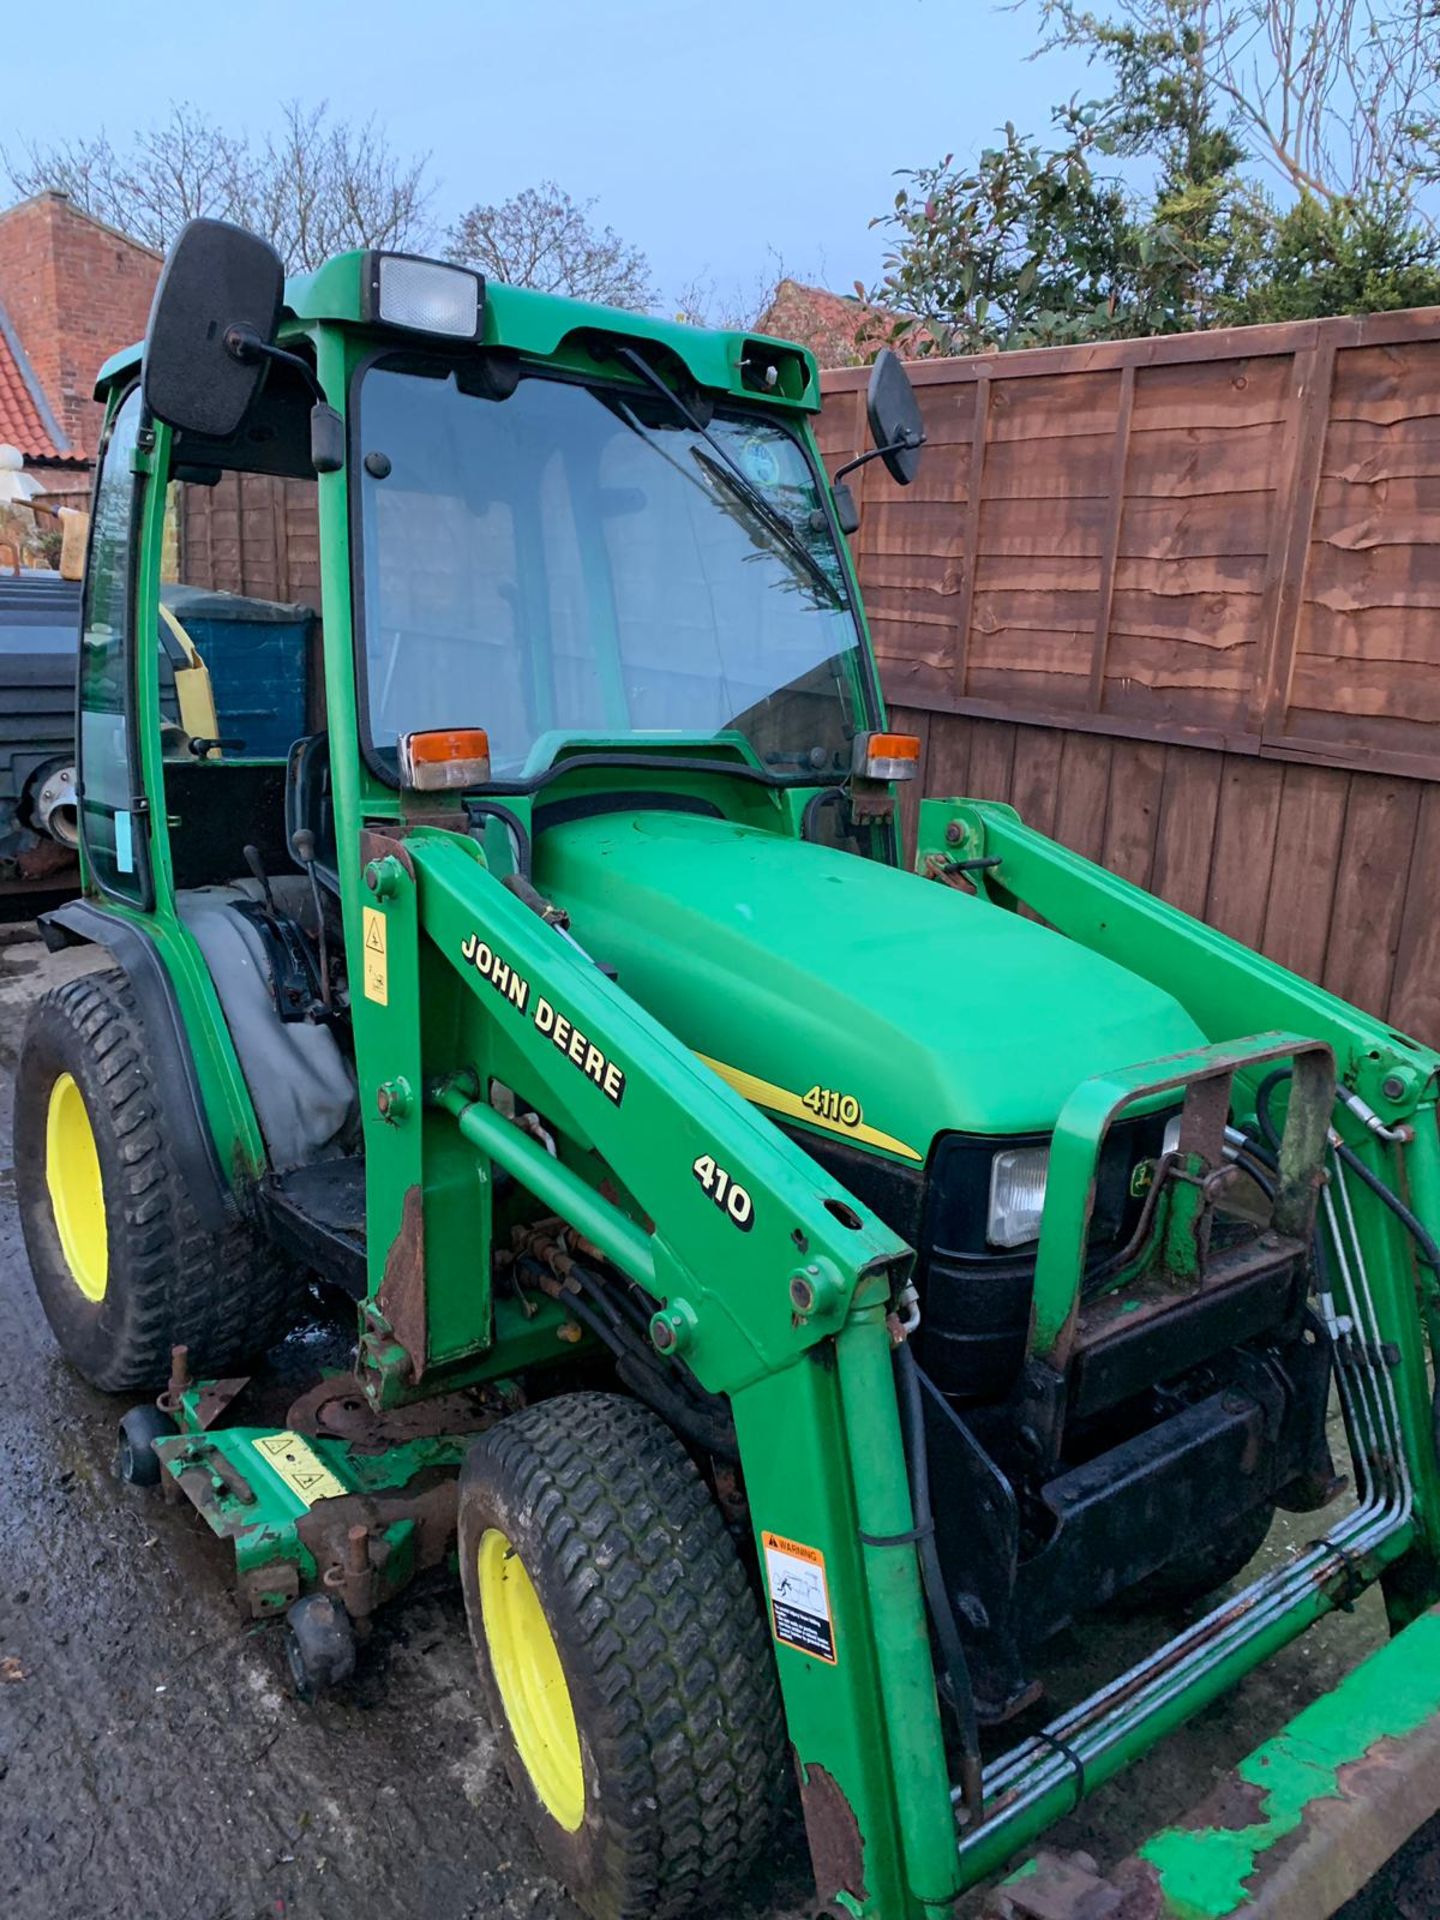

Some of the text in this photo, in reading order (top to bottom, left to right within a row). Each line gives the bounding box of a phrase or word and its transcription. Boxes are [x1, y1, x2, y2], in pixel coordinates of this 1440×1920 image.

[461, 933, 626, 1105] JOHN DEERE
[803, 1085, 860, 1127] 4110
[692, 1154, 753, 1230] 410
[780, 1539, 817, 1561] WARNING
